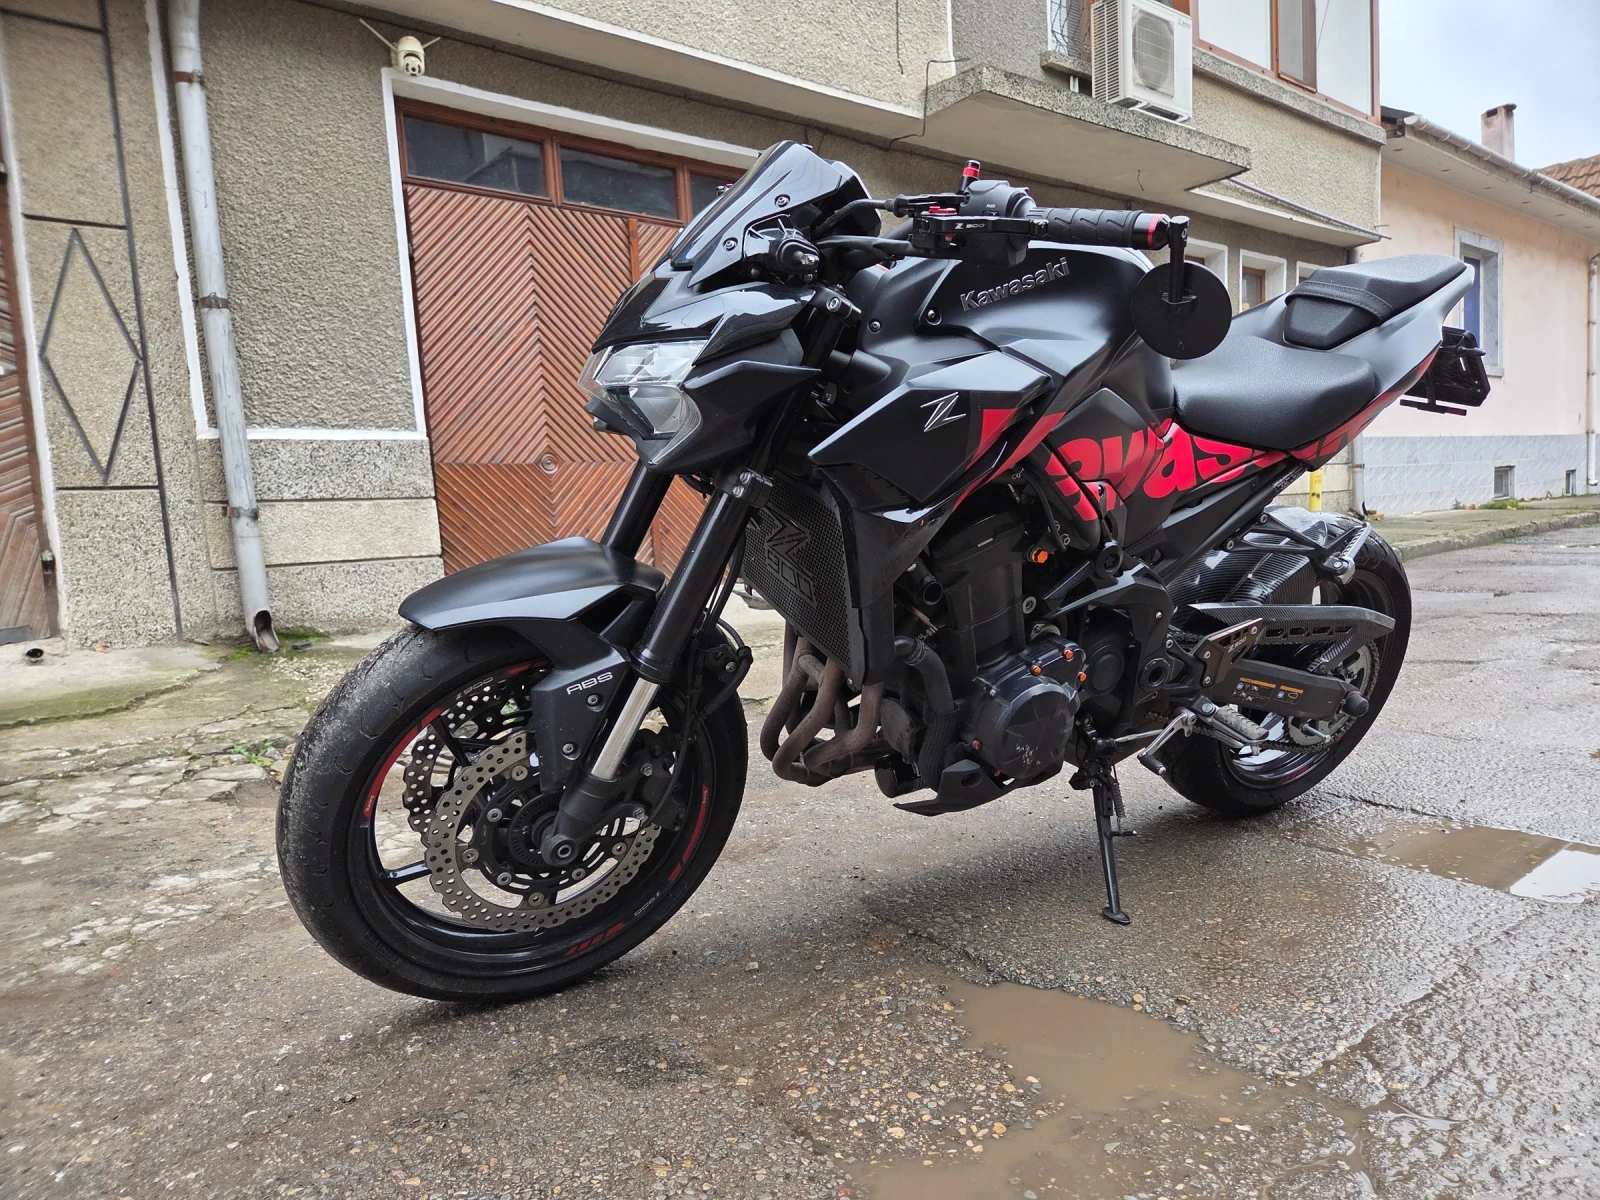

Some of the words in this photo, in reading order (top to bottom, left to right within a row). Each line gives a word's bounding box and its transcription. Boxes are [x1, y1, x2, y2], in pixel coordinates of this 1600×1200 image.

[954, 222, 964, 230] Z
[960, 256, 1070, 312] Kawasaki
[920, 391, 967, 433] Z
[566, 671, 614, 695] ABS
